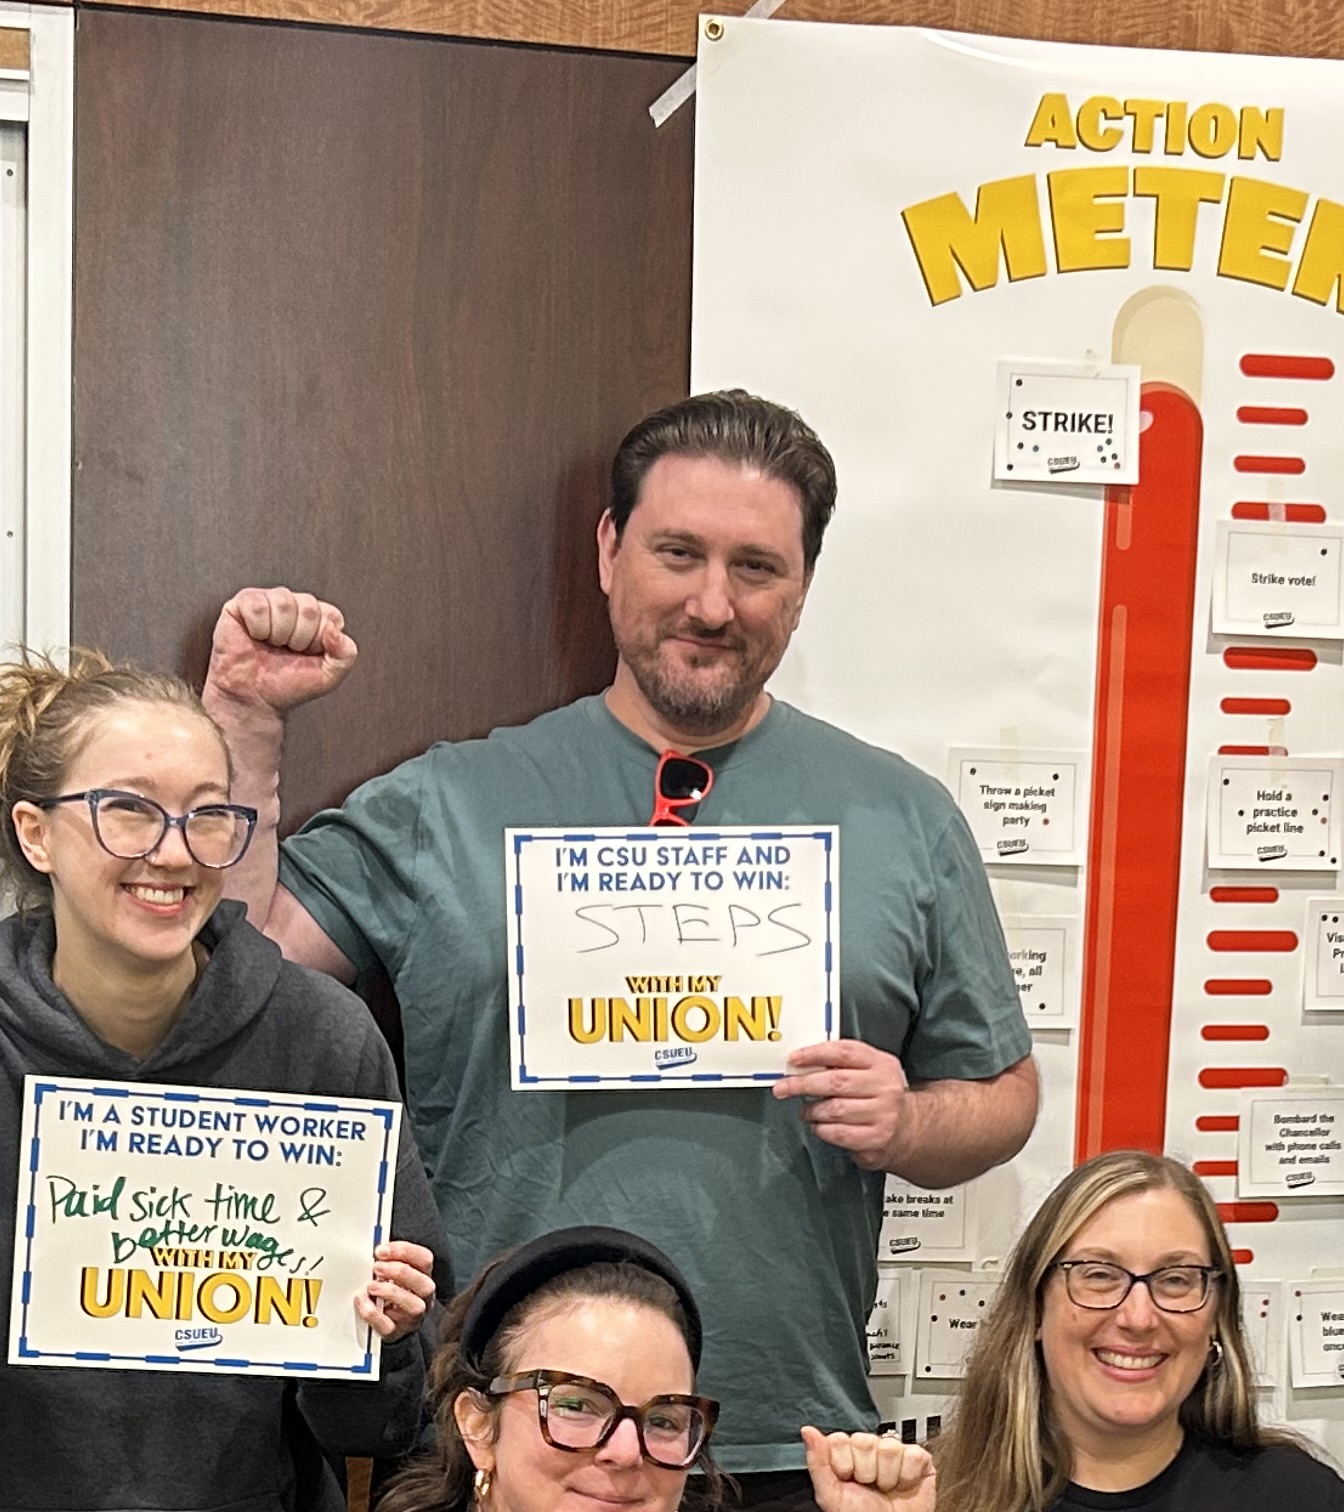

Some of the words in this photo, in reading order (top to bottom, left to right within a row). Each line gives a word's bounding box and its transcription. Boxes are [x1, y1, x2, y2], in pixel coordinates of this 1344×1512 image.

[1024, 93, 1285, 161] ACTION
[1022, 410, 1114, 434] STRIKE!
[1251, 572, 1284, 585] Strike
[1288, 575, 1316, 587] vote!
[980, 785, 1011, 796] Throw
[1023, 786, 1055, 798] picket
[1257, 790, 1283, 801] Hold
[1002, 815, 1030, 827] party
[1253, 807, 1298, 819] practice
[1246, 822, 1281, 835] picket
[1283, 823, 1304, 834] line
[556, 847, 588, 867] I'M
[597, 846, 647, 866] CSU
[656, 846, 728, 866] STAFF
[736, 845, 791, 865] AND
[557, 872, 589, 892] I'M
[598, 872, 683, 892] READY
[690, 871, 724, 891] TO
[732, 871, 790, 891] WIN:
[575, 902, 811, 957] STEPS
[625, 976, 683, 993] WITH
[688, 975, 722, 992] MY
[568, 995, 783, 1044] UNION!
[655, 1047, 693, 1061] CSUEU
[58, 1100, 94, 1123] I'M
[102, 1104, 122, 1124] A
[131, 1105, 247, 1133] STUDENT
[255, 1113, 367, 1141] WORKER
[80, 1128, 118, 1152] I'M
[128, 1133, 225, 1158] READY
[232, 1138, 269, 1161] TO
[279, 1142, 343, 1167] WIN:
[46, 1175, 127, 1224] Paid
[129, 1186, 193, 1223] sick
[205, 1183, 280, 1224] time
[297, 1188, 330, 1227] &
[113, 1220, 220, 1263] better
[150, 1247, 214, 1270] WITH
[219, 1251, 257, 1270] MY
[80, 1266, 324, 1328] UNION!
[174, 1327, 219, 1342] CSUEU
